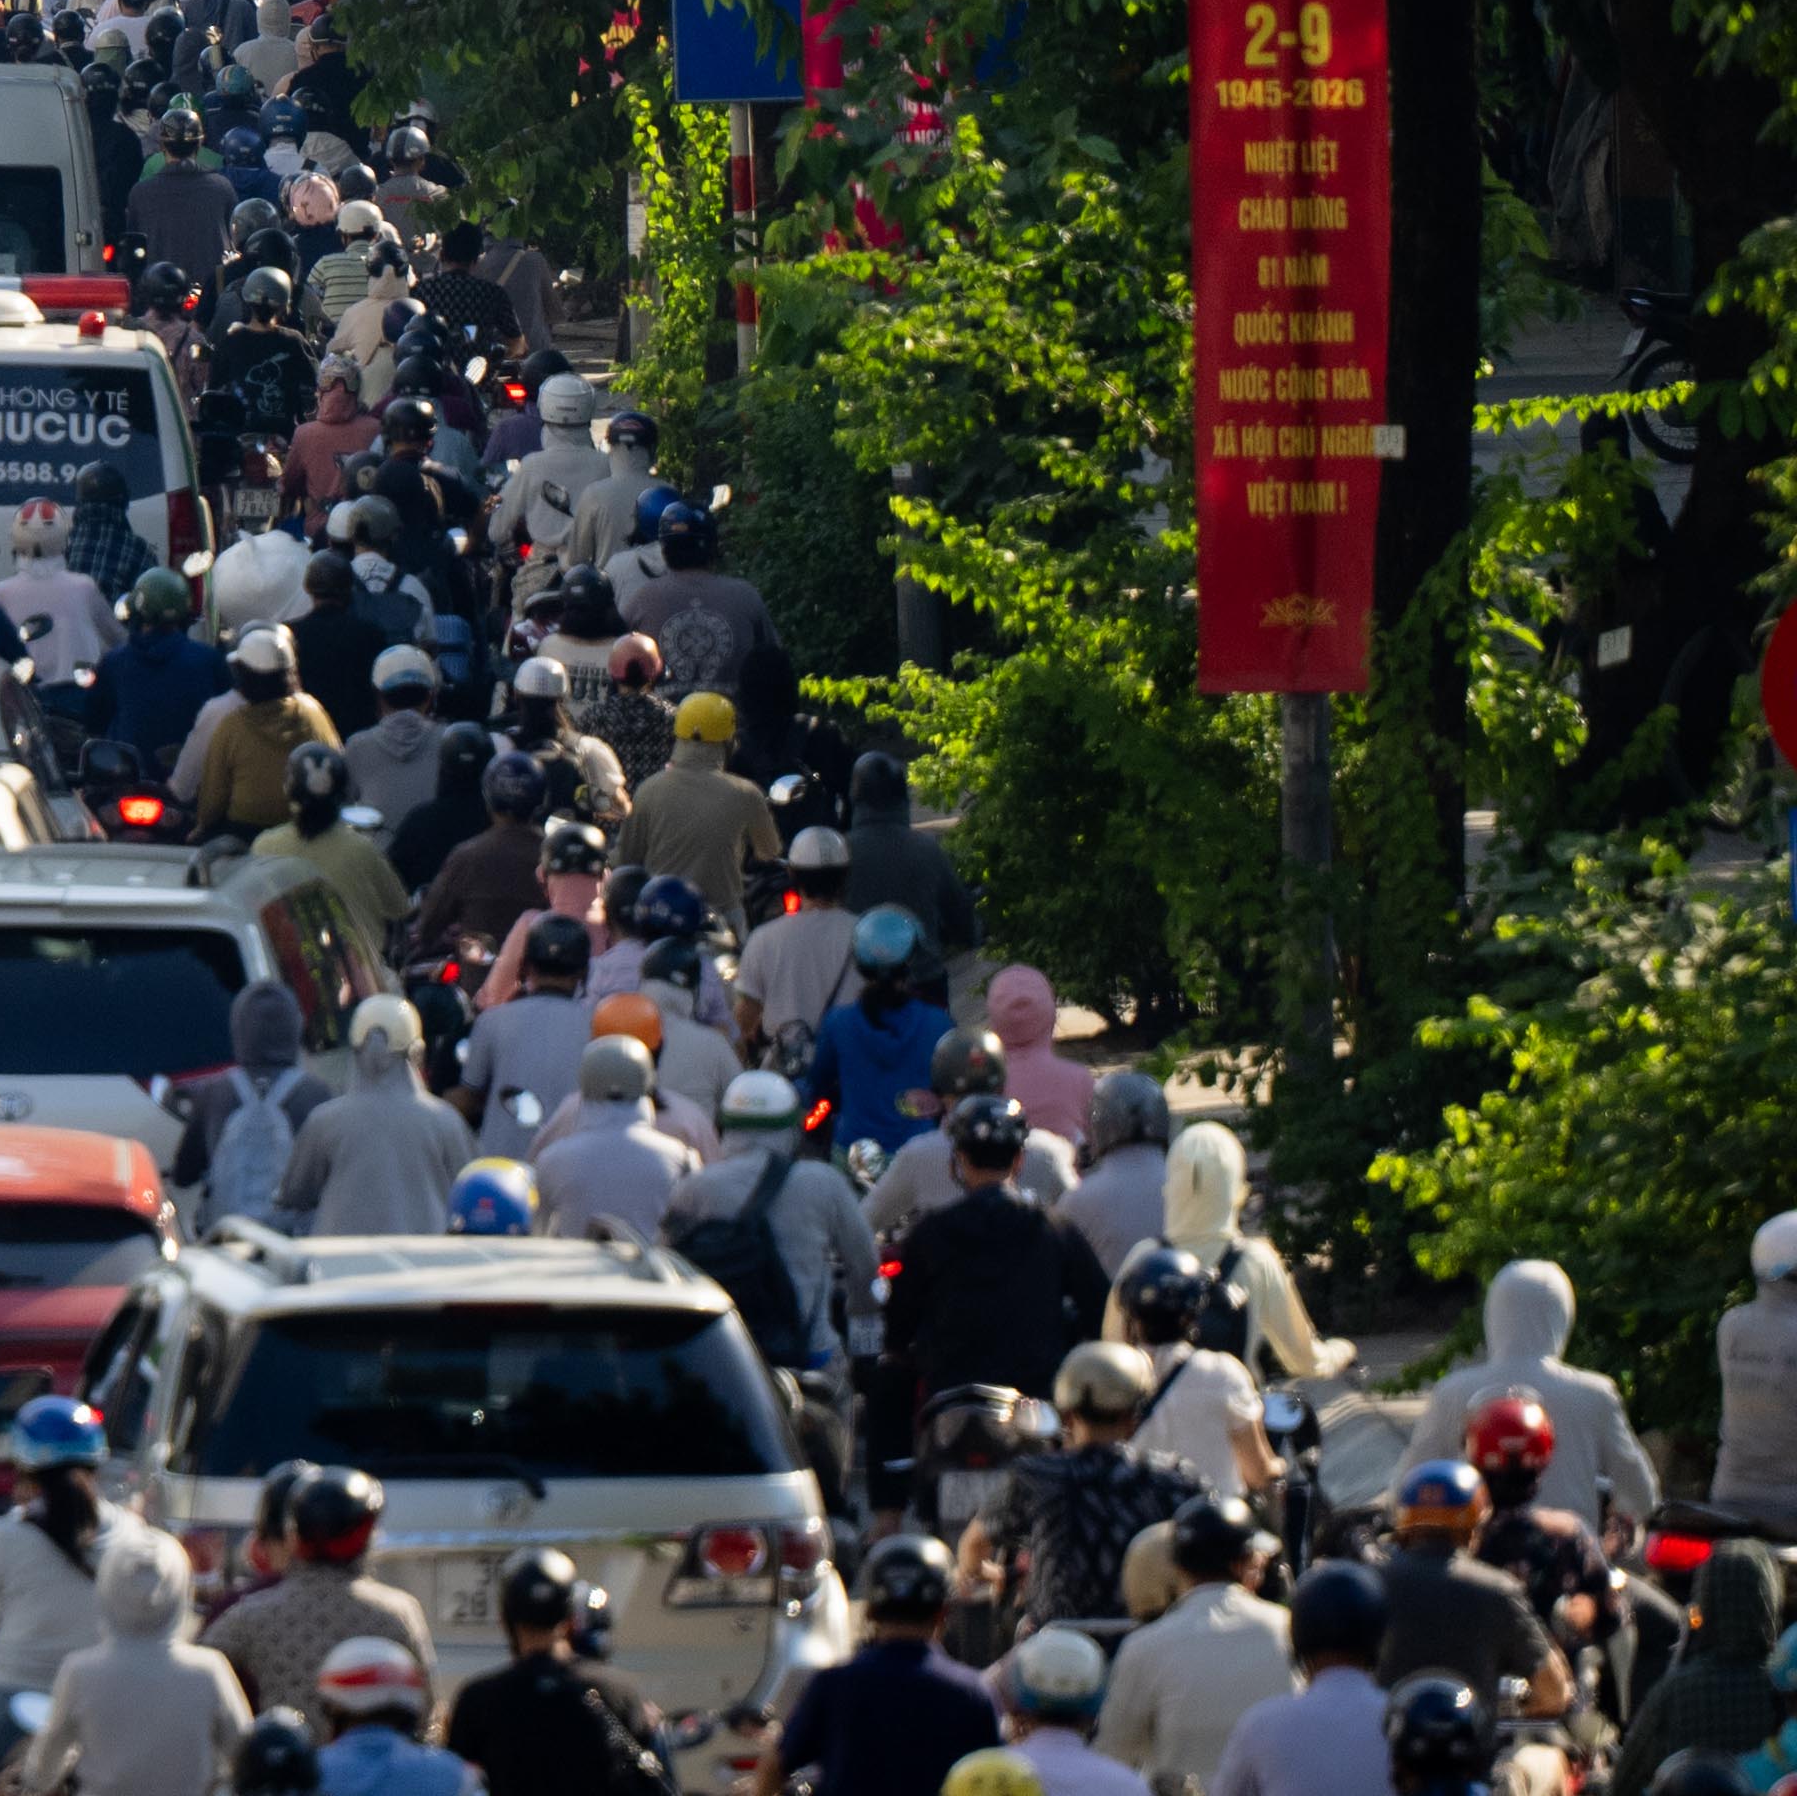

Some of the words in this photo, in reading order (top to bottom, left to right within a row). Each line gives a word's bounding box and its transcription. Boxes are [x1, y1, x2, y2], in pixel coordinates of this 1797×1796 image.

[1244, 2, 1331, 67] 2-9
[1216, 78, 1366, 108] 1945-2026
[1244, 135, 1295, 179] NHIỆT
[1301, 134, 1339, 180] LIỆT
[1234, 302, 1283, 347] QUỐC
[1289, 306, 1354, 344] KHÁNH
[84, 390, 101, 408] Y
[1219, 363, 1271, 402] NƯỚC
[1275, 362, 1327, 407] CỘNG
[1213, 420, 1238, 460] XÃ
[1241, 420, 1274, 466] HỘI
[1247, 475, 1287, 522] VIỆT
[1290, 482, 1335, 514] NAM
